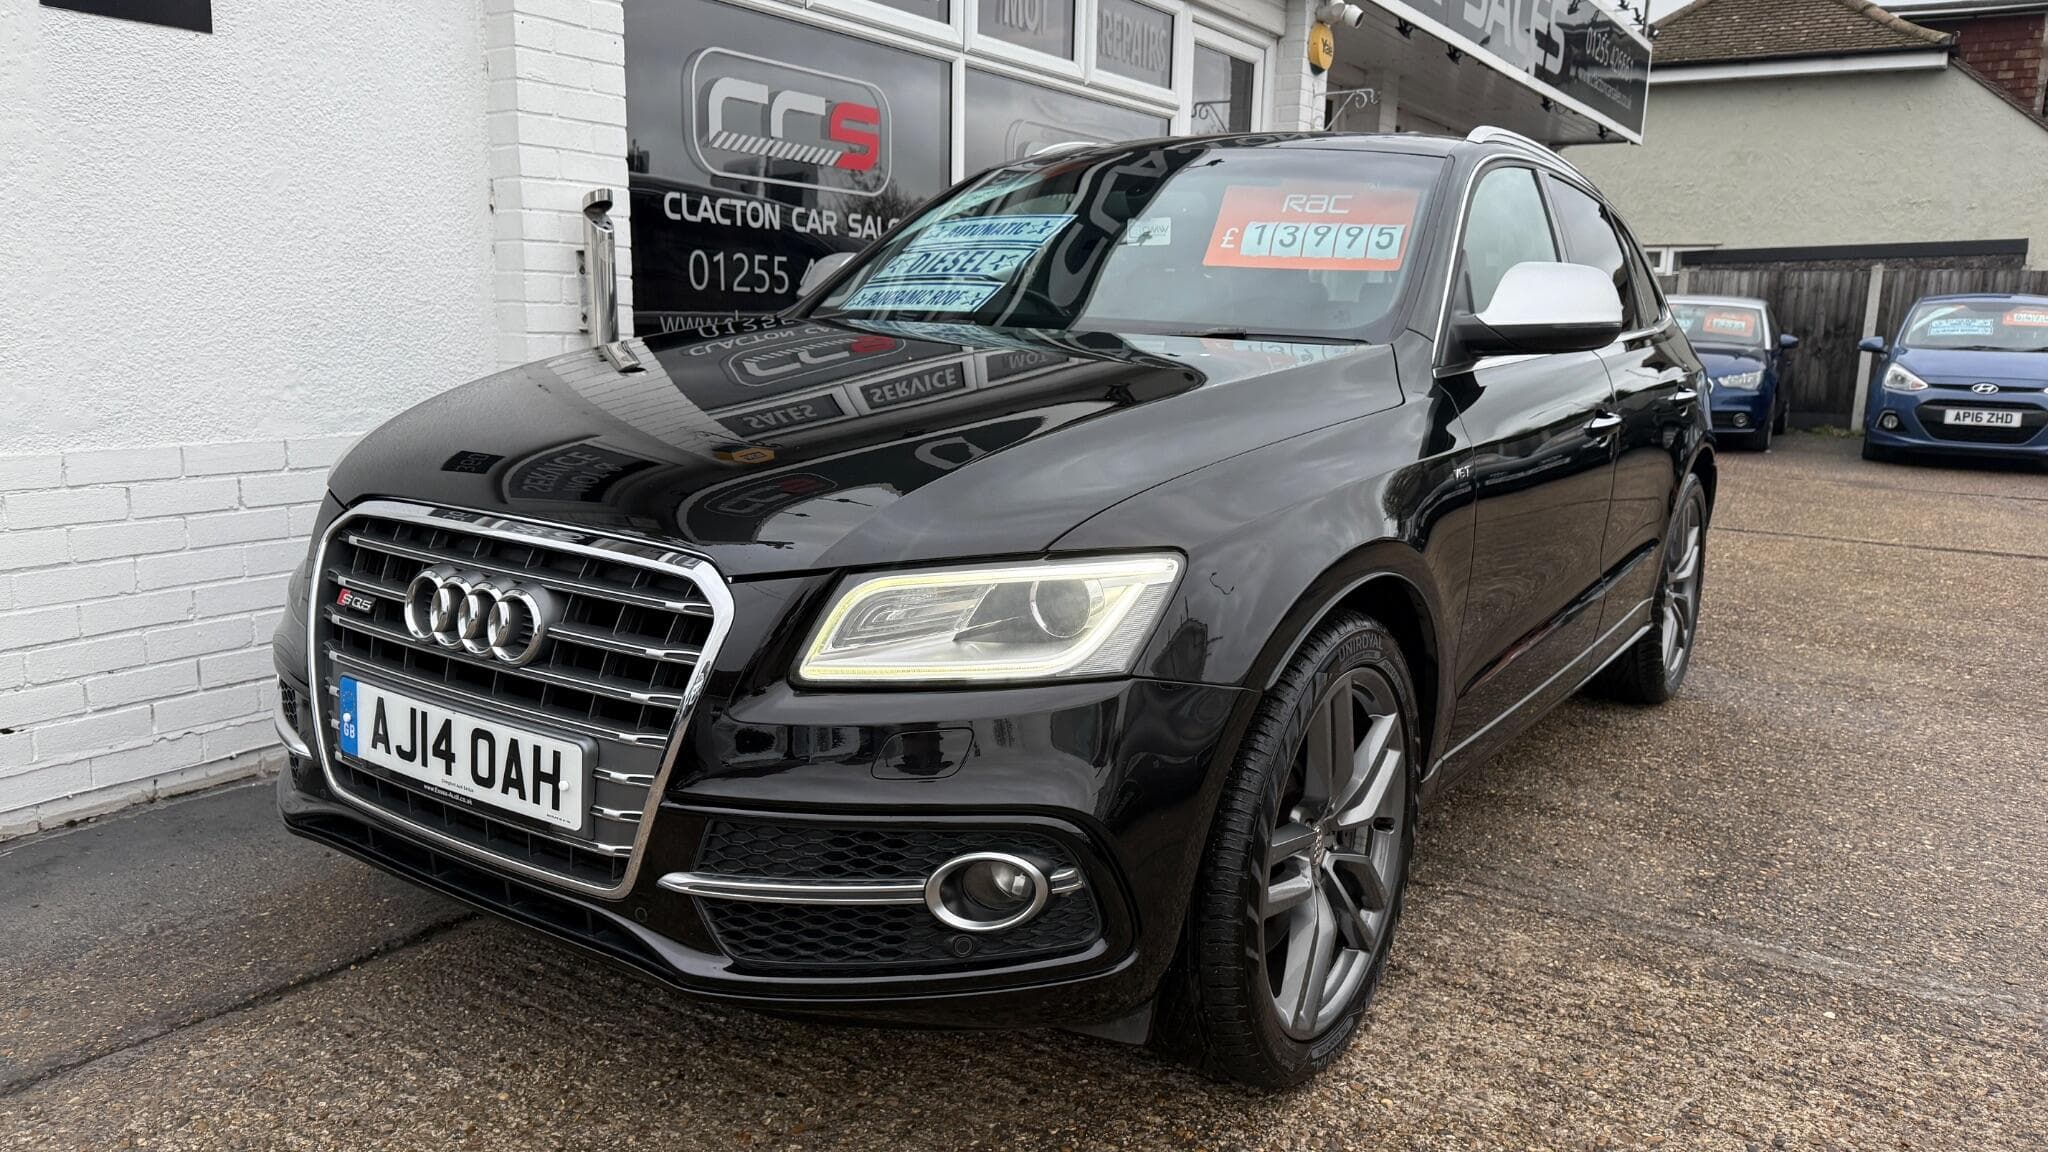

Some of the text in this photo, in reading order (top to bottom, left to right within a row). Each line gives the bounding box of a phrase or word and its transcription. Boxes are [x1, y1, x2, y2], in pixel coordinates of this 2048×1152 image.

[1101, 9, 1168, 72] REPAIRS
[663, 191, 781, 231] CLACTON
[791, 207, 838, 236] CAR
[947, 221, 1030, 238] AUTOMATIC
[688, 248, 789, 294] 01255
[904, 249, 995, 274] DIESEL
[928, 289, 966, 307] ROOF
[1953, 410, 2014, 425] AP16 ZHD
[1338, 631, 1383, 661] UNIROYAL
[343, 723, 356, 740] GB
[371, 696, 562, 812] AJ14 OAH
